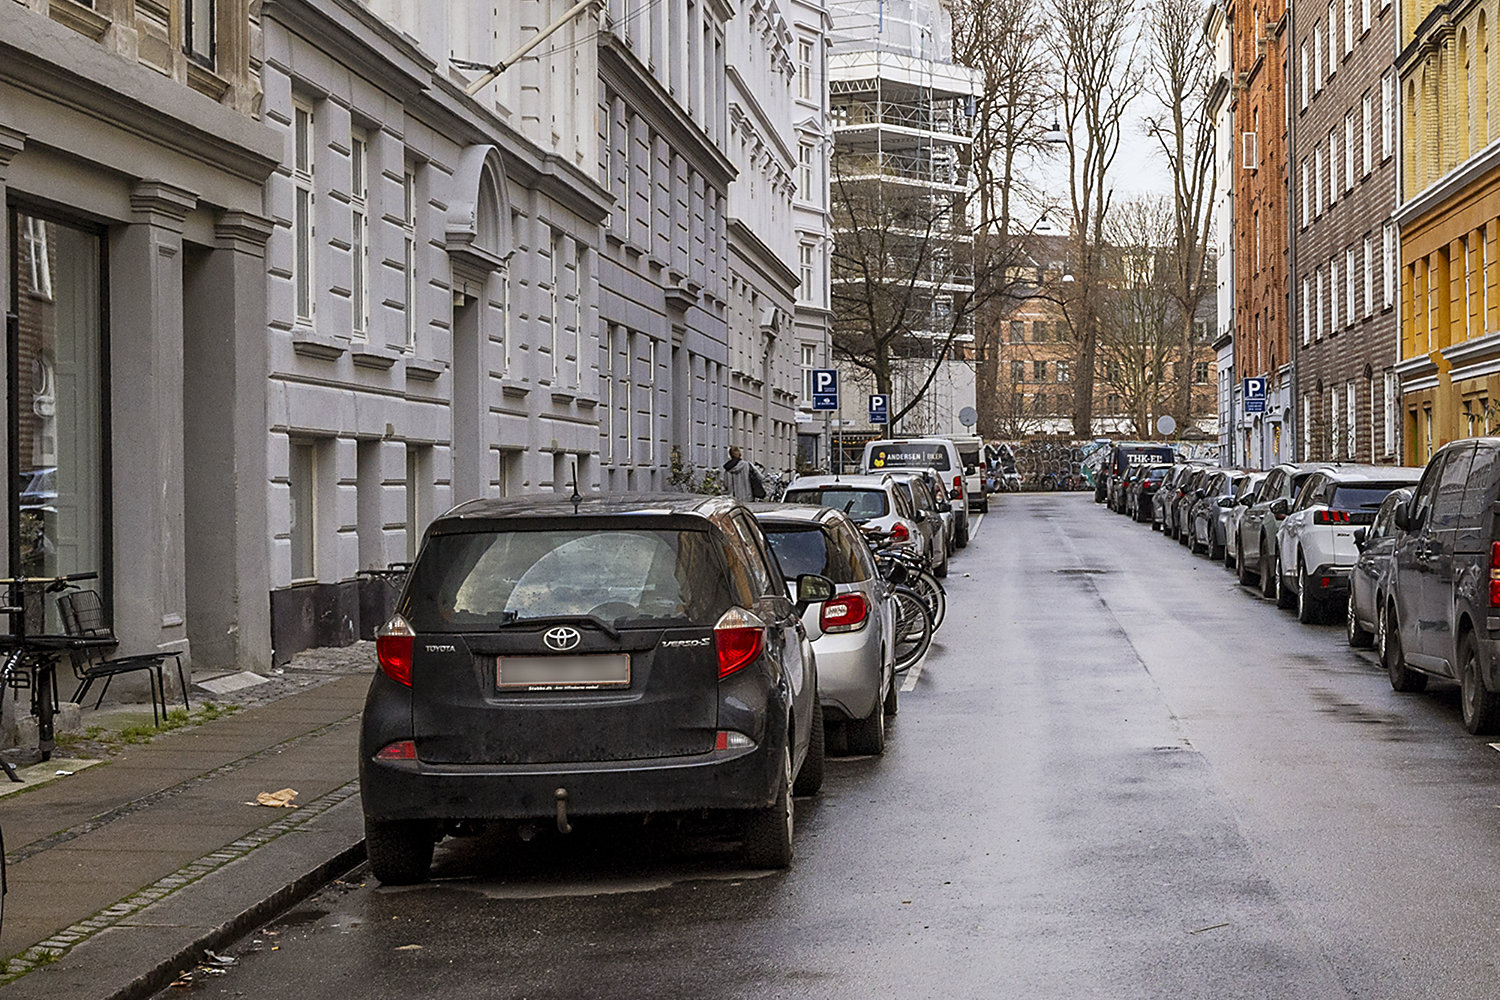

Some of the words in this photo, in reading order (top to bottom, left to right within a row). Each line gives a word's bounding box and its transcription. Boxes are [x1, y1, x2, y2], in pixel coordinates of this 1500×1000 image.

[817, 372, 832, 392] P
[1248, 380, 1261, 397] P
[872, 396, 884, 411] P
[887, 453, 921, 461] ANDERSEN
[425, 645, 456, 653] TOYOTA
